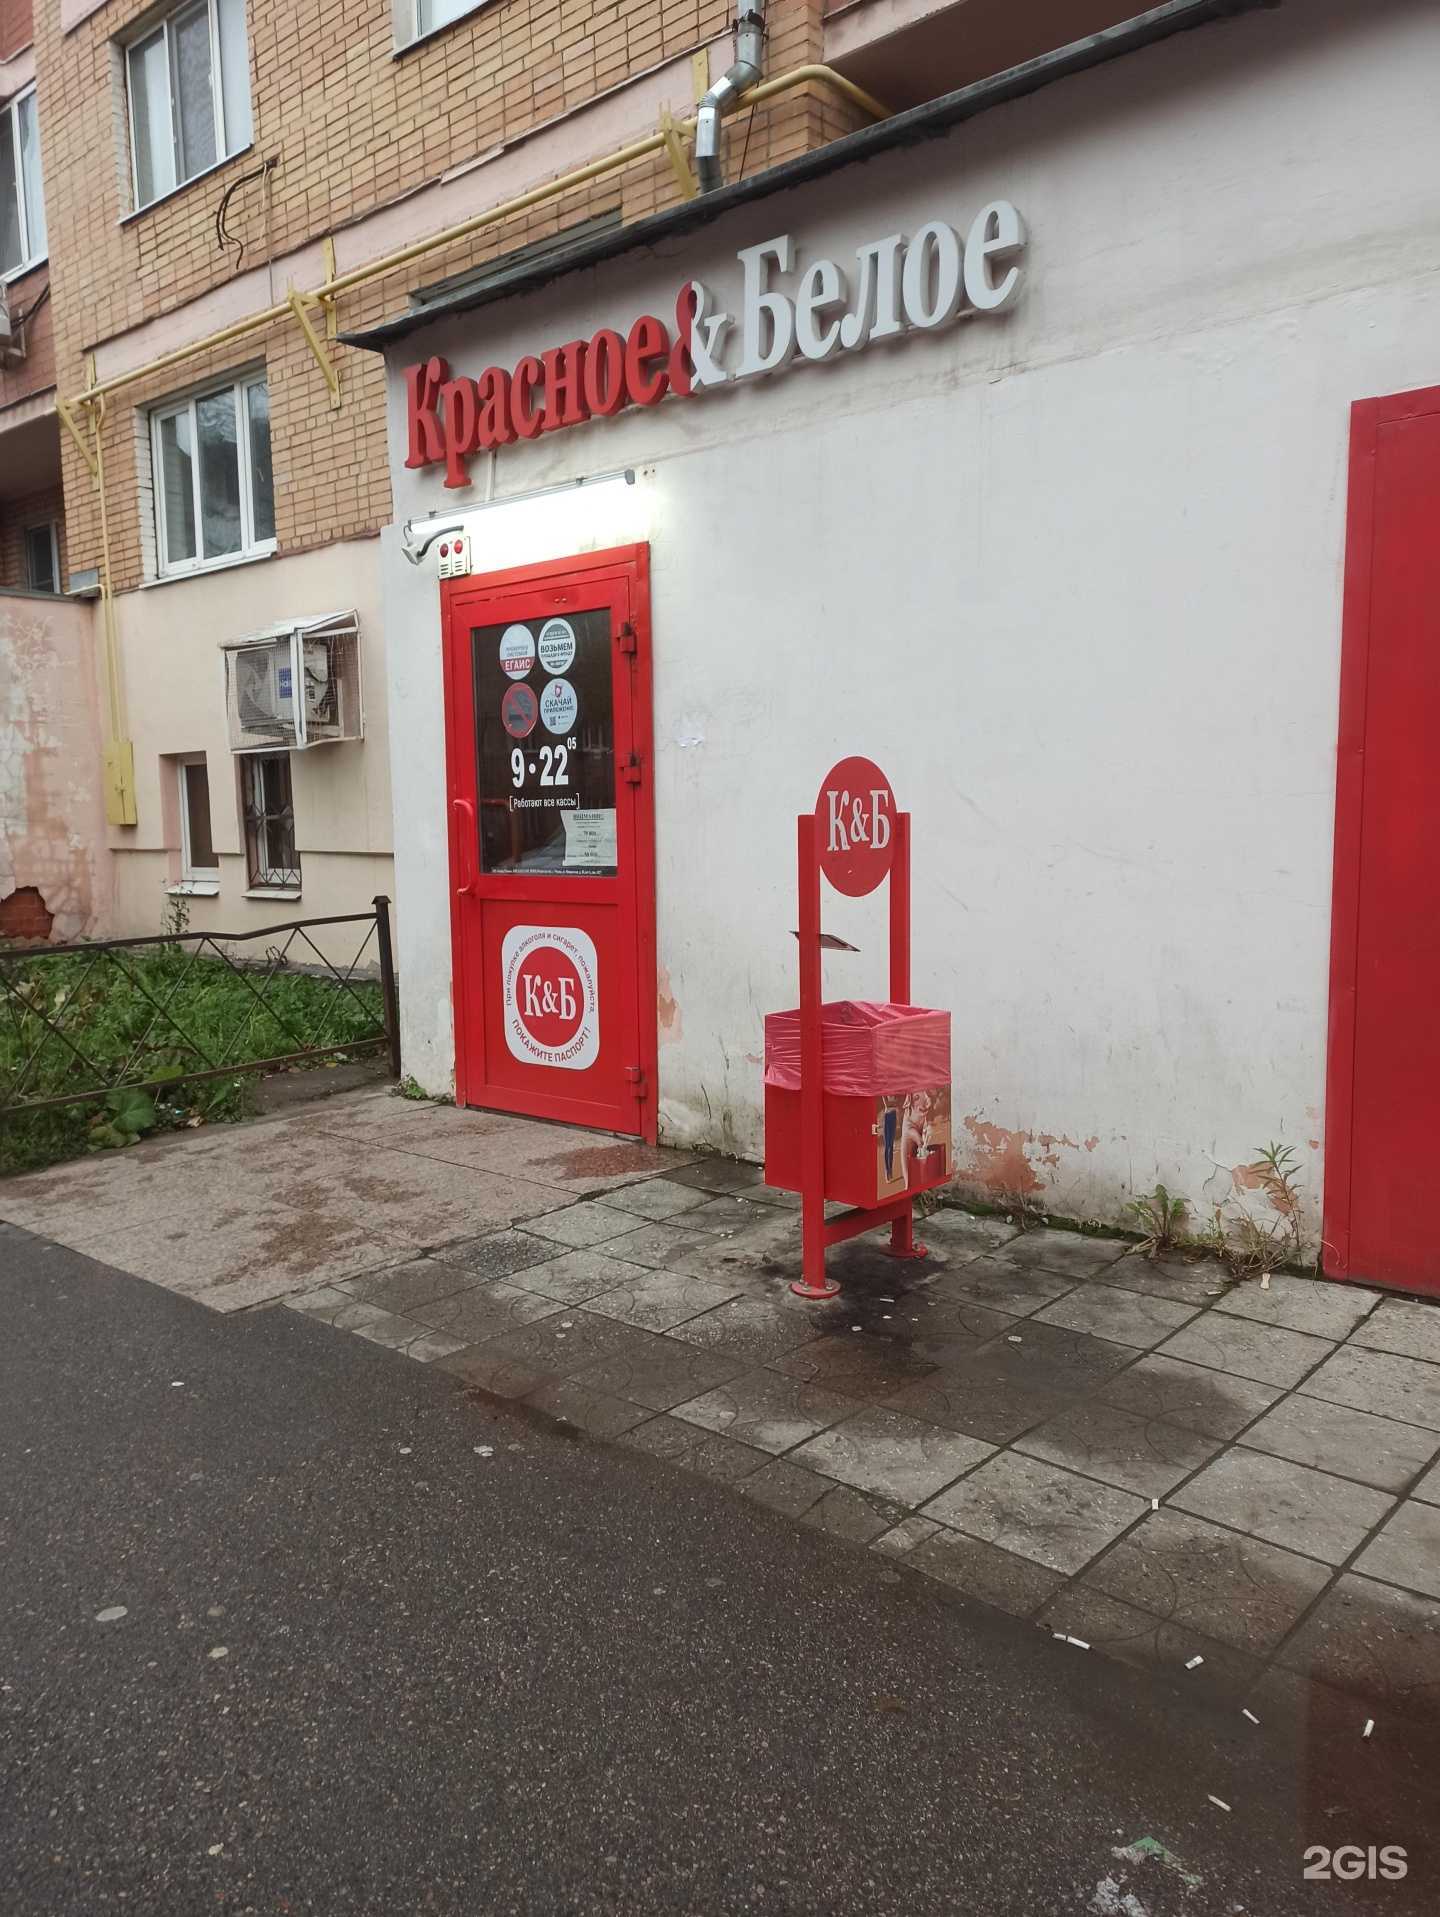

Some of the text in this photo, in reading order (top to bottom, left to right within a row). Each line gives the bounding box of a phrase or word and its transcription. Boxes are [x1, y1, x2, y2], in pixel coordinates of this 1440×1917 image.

[505, 659, 531, 671] ЕГАИС
[545, 697, 572, 708] СКАЧАЙ
[543, 798, 555, 807] все
[507, 951, 520, 985] покупке
[518, 932, 546, 953] алкоголя
[512, 1019, 592, 1063] ПОКАЖИТЕ ПАСПОРТ!
